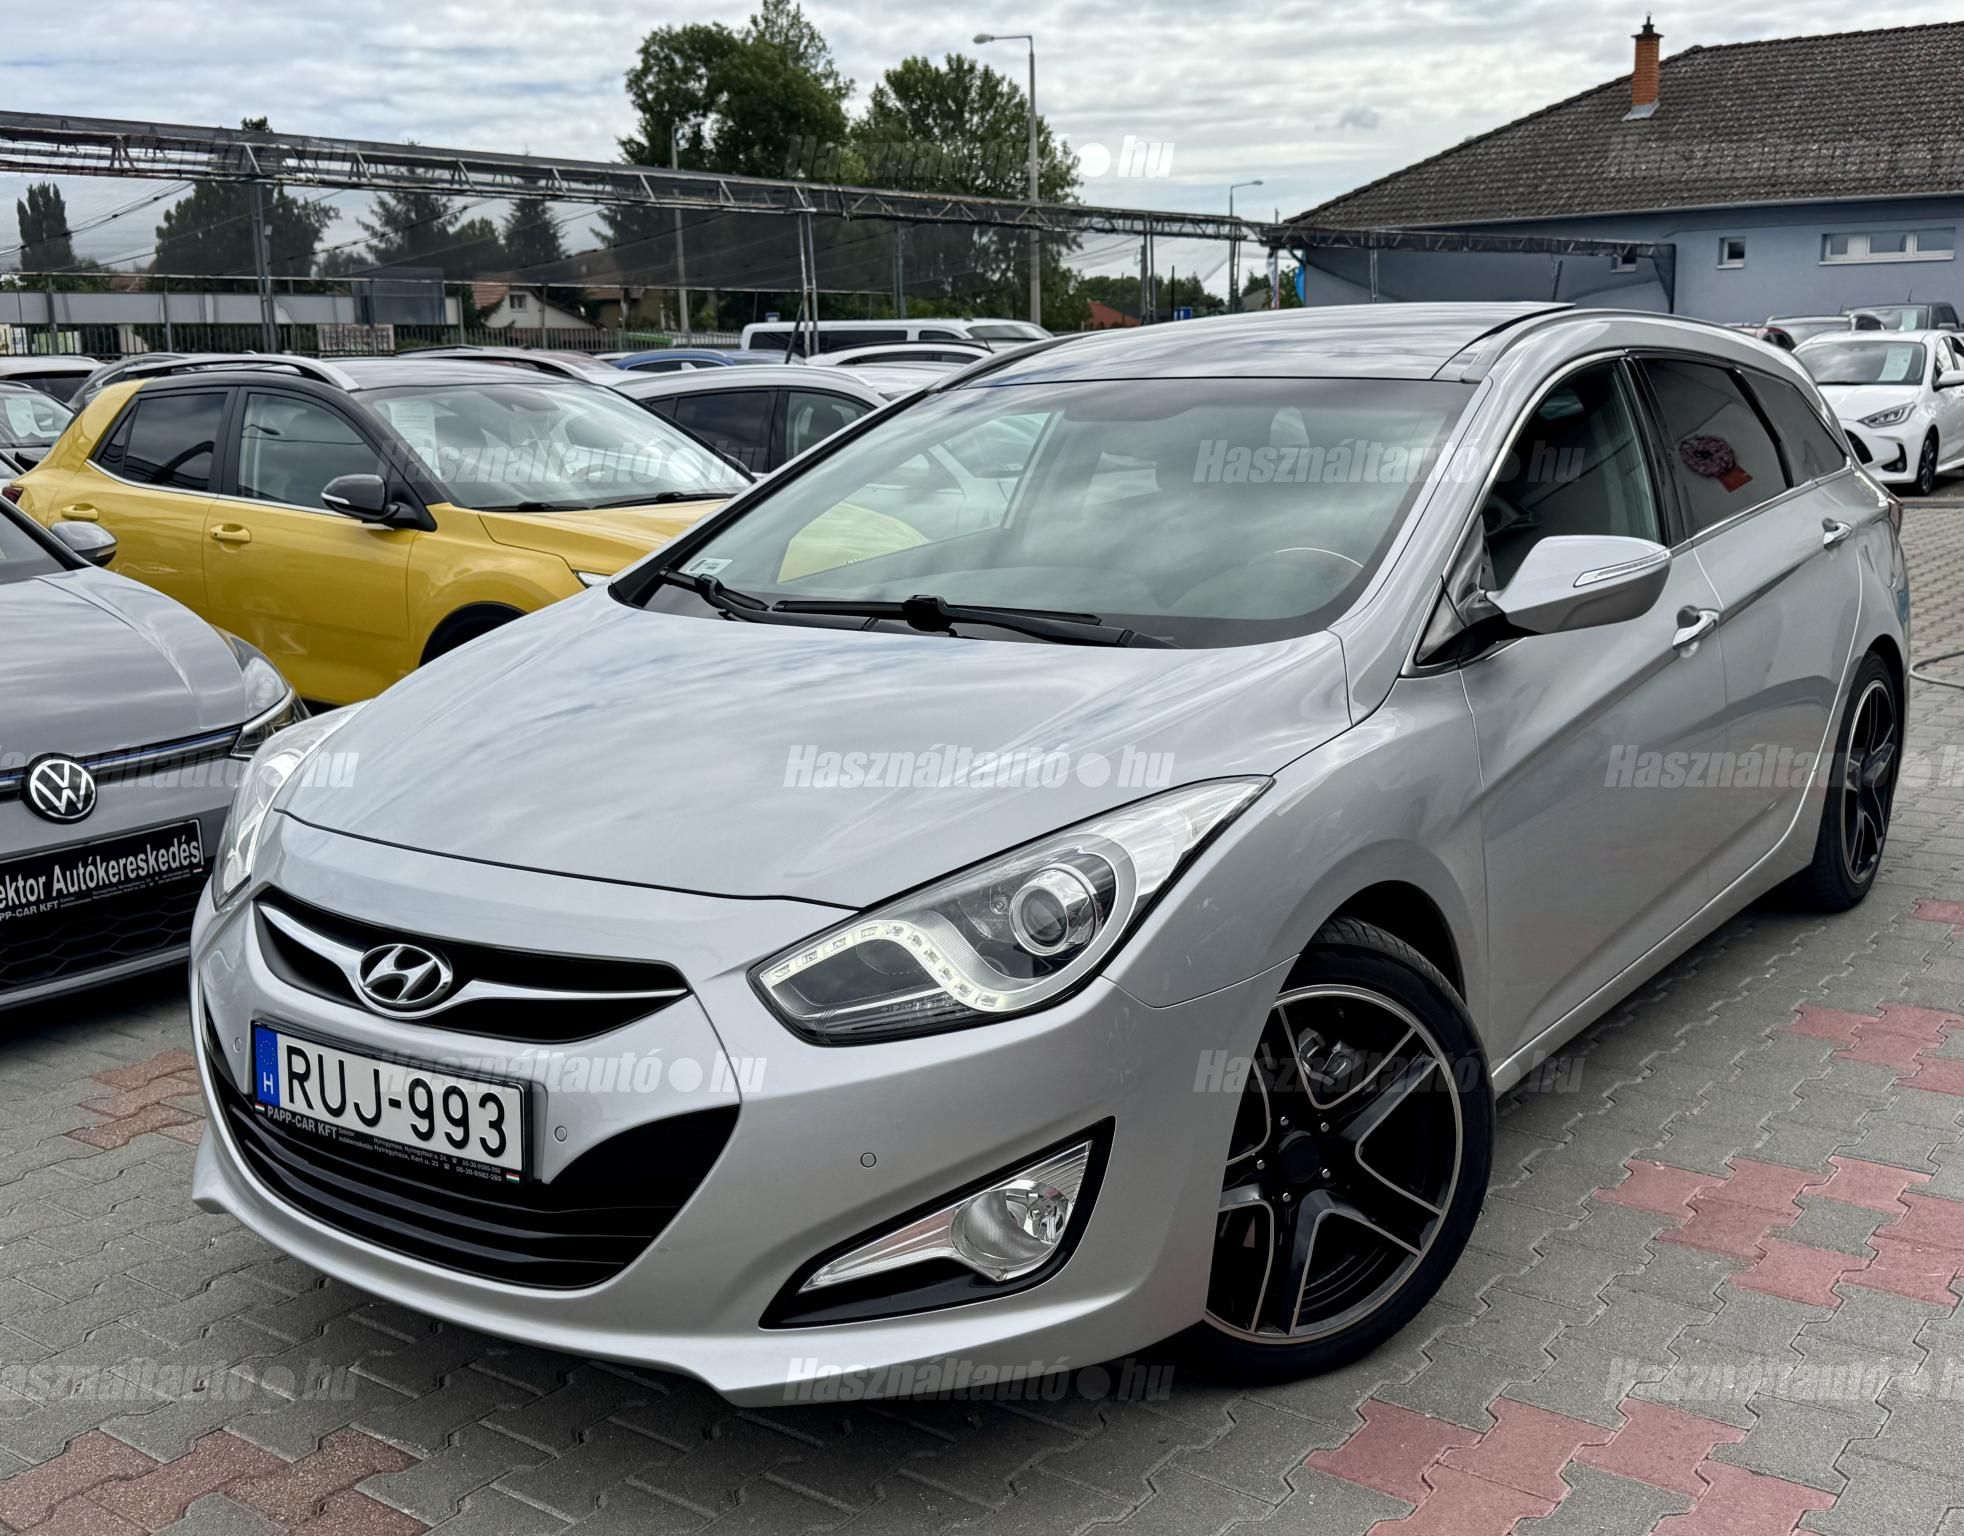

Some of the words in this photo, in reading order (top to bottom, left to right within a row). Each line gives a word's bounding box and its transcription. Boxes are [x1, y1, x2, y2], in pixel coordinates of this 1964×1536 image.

[52, 835, 201, 897] Autókereskedés
[39, 900, 59, 913] KFT
[263, 1071, 274, 1095] H
[286, 1044, 507, 1158] RUJ-993
[267, 1106, 316, 1132] PAPP-CAR
[317, 1123, 338, 1139] KFT
